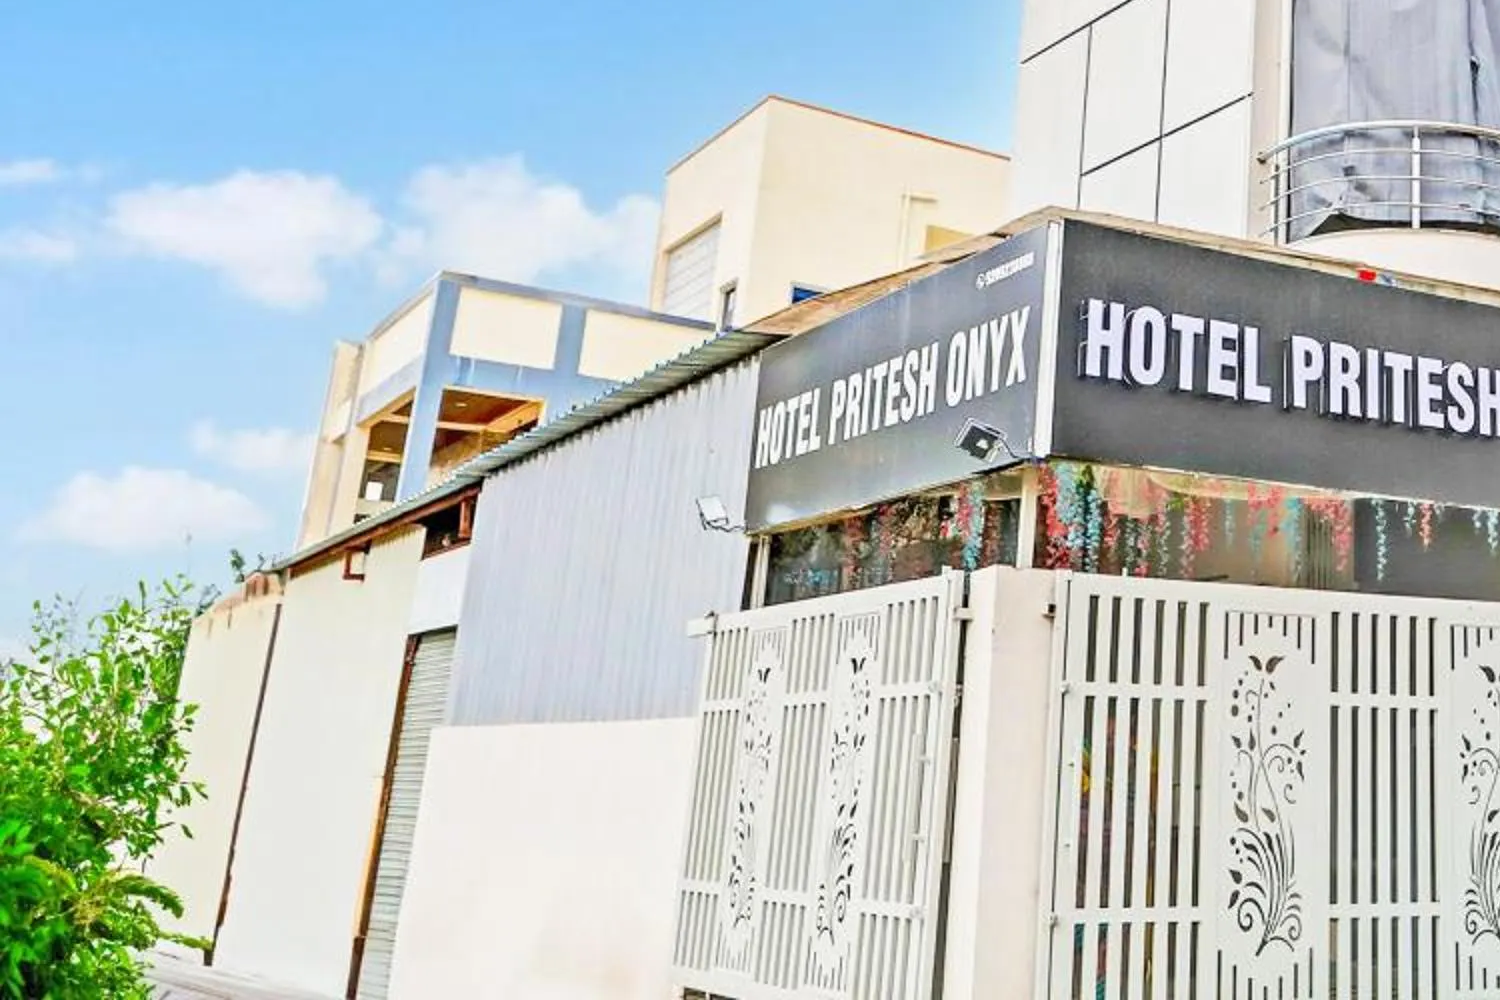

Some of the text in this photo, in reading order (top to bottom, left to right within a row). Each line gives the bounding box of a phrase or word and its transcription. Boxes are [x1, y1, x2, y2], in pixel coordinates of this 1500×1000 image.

[754, 305, 1031, 469] HOTEL PRITESH ONYX
[1083, 298, 1271, 404] HOTEL
